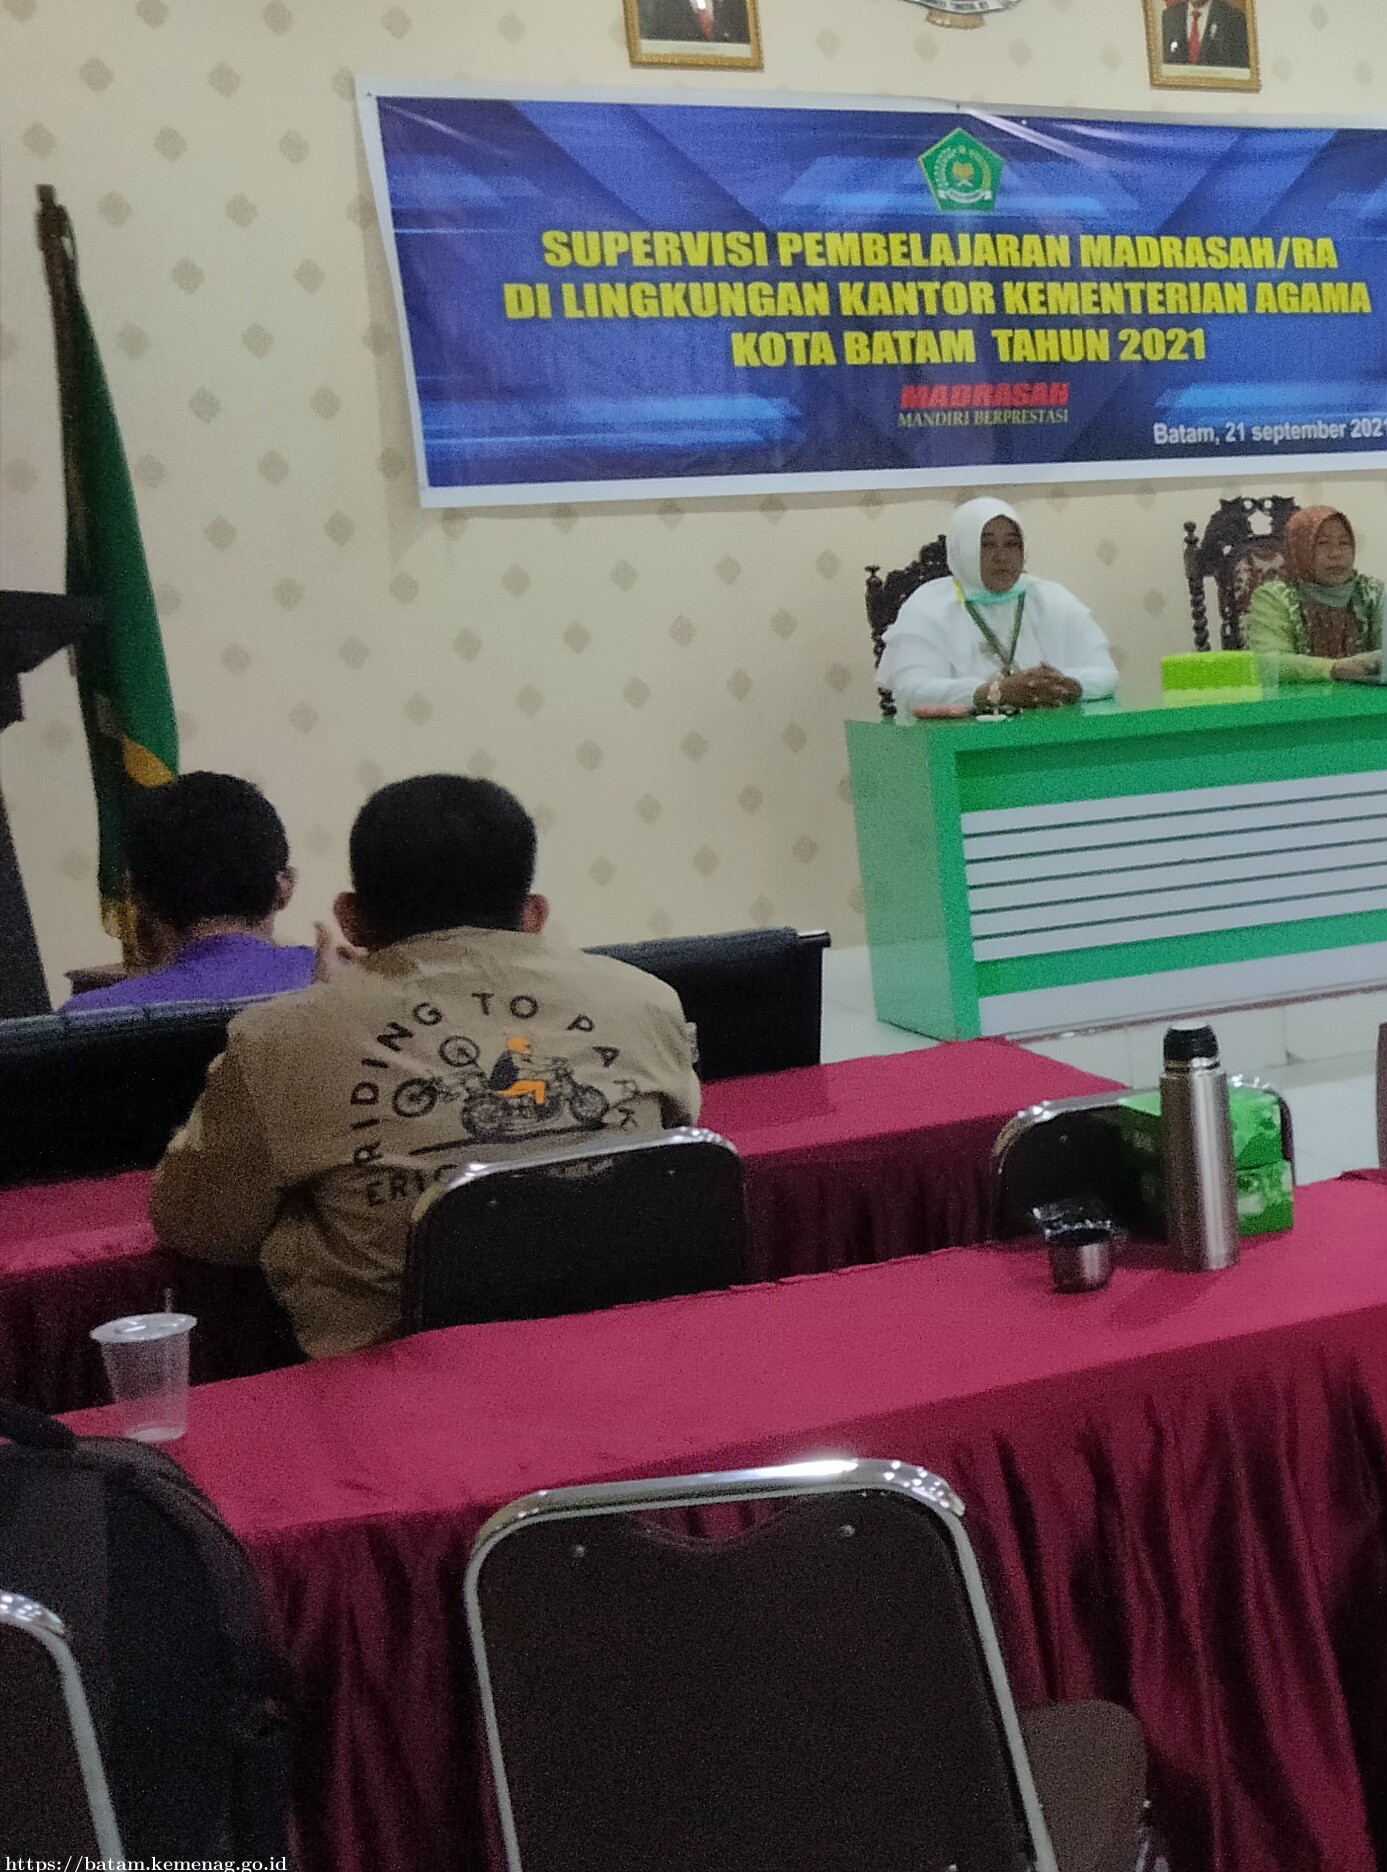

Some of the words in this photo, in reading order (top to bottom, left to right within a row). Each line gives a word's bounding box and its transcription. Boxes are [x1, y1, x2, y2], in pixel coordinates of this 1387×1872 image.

[541, 230, 768, 268] SUPERVISI
[777, 232, 1070, 268] PEMBELAJARAN
[1080, 234, 1339, 270] MADRASAH/RA
[503, 283, 552, 319] DI
[561, 282, 830, 318] LINGKUNGAN
[838, 281, 995, 316] KANTOR
[1002, 281, 1248, 315] KEMENTERIAN
[1255, 282, 1372, 314] AGAMA
[731, 331, 837, 367] KOTA
[843, 329, 976, 365] BATAM
[991, 329, 1110, 362] TAHUN
[1118, 327, 1206, 361] 2021
[902, 382, 1069, 409] MADRASAH
[899, 410, 970, 428] MANDIRI
[974, 408, 1069, 426] BERPRESTASI
[1153, 422, 1220, 445] Batam,
[1225, 421, 1246, 442] 21
[1252, 420, 1346, 445] september
[351, 1001, 443, 1166] RIDING
[471, 991, 539, 1019] TO
[566, 1013, 641, 1132] PARK
